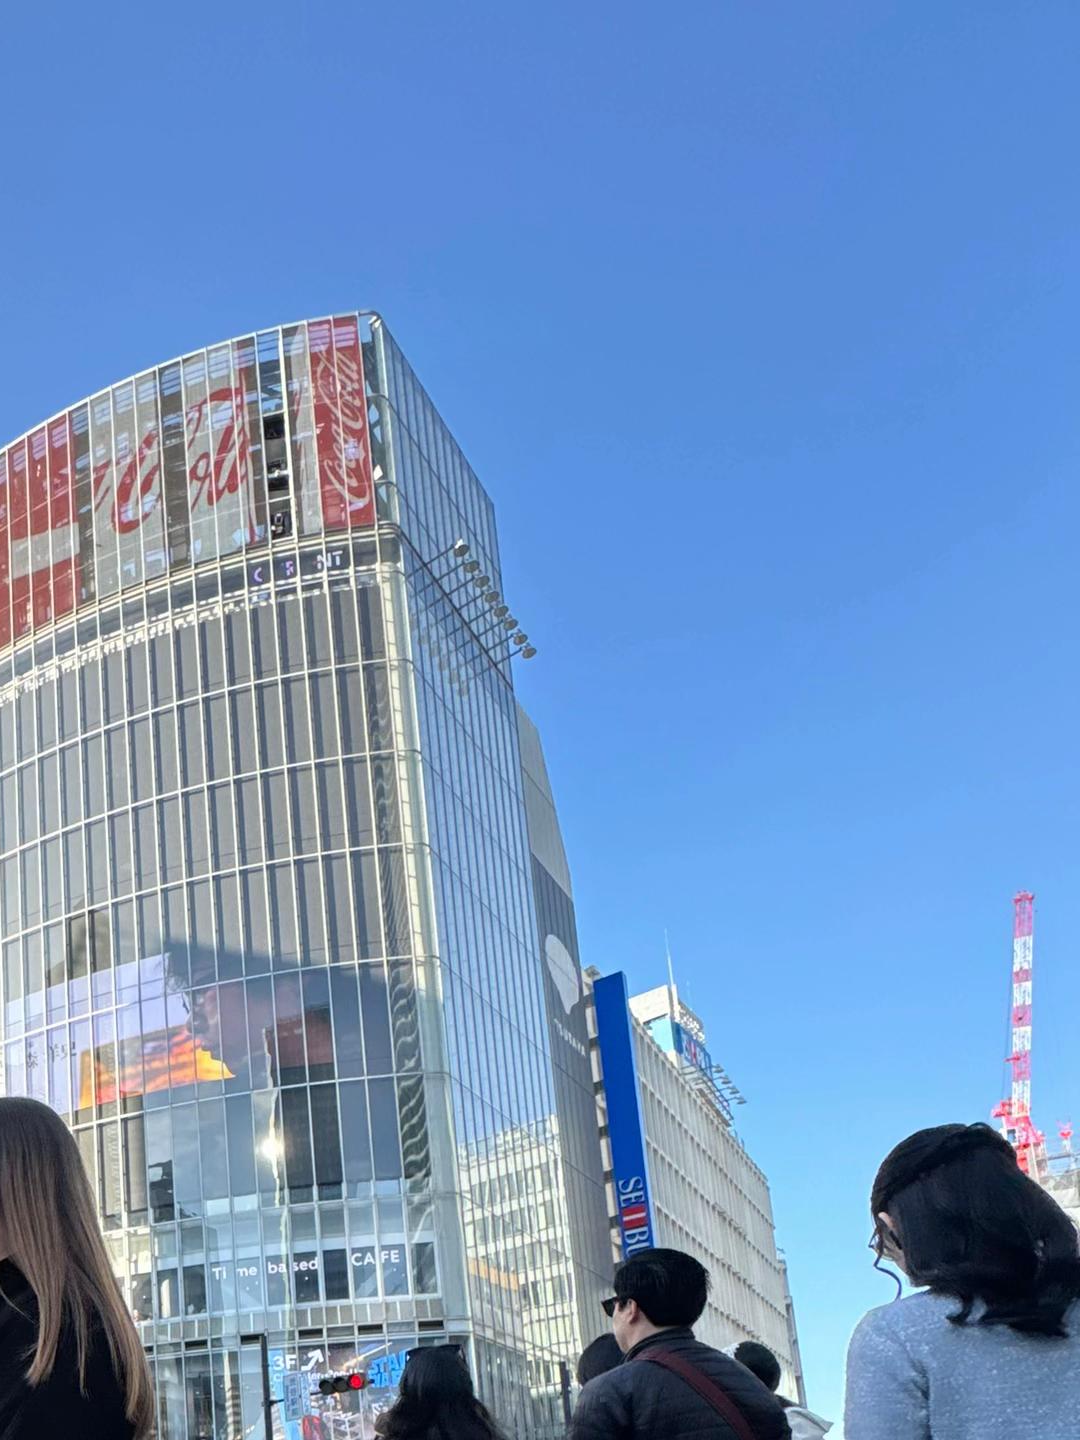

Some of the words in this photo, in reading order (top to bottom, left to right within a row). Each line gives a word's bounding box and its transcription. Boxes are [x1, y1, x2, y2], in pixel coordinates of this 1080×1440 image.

[268, 1256, 319, 1275] based
[351, 1249, 401, 1267] CAFE
[273, 1354, 297, 1371] 3F
